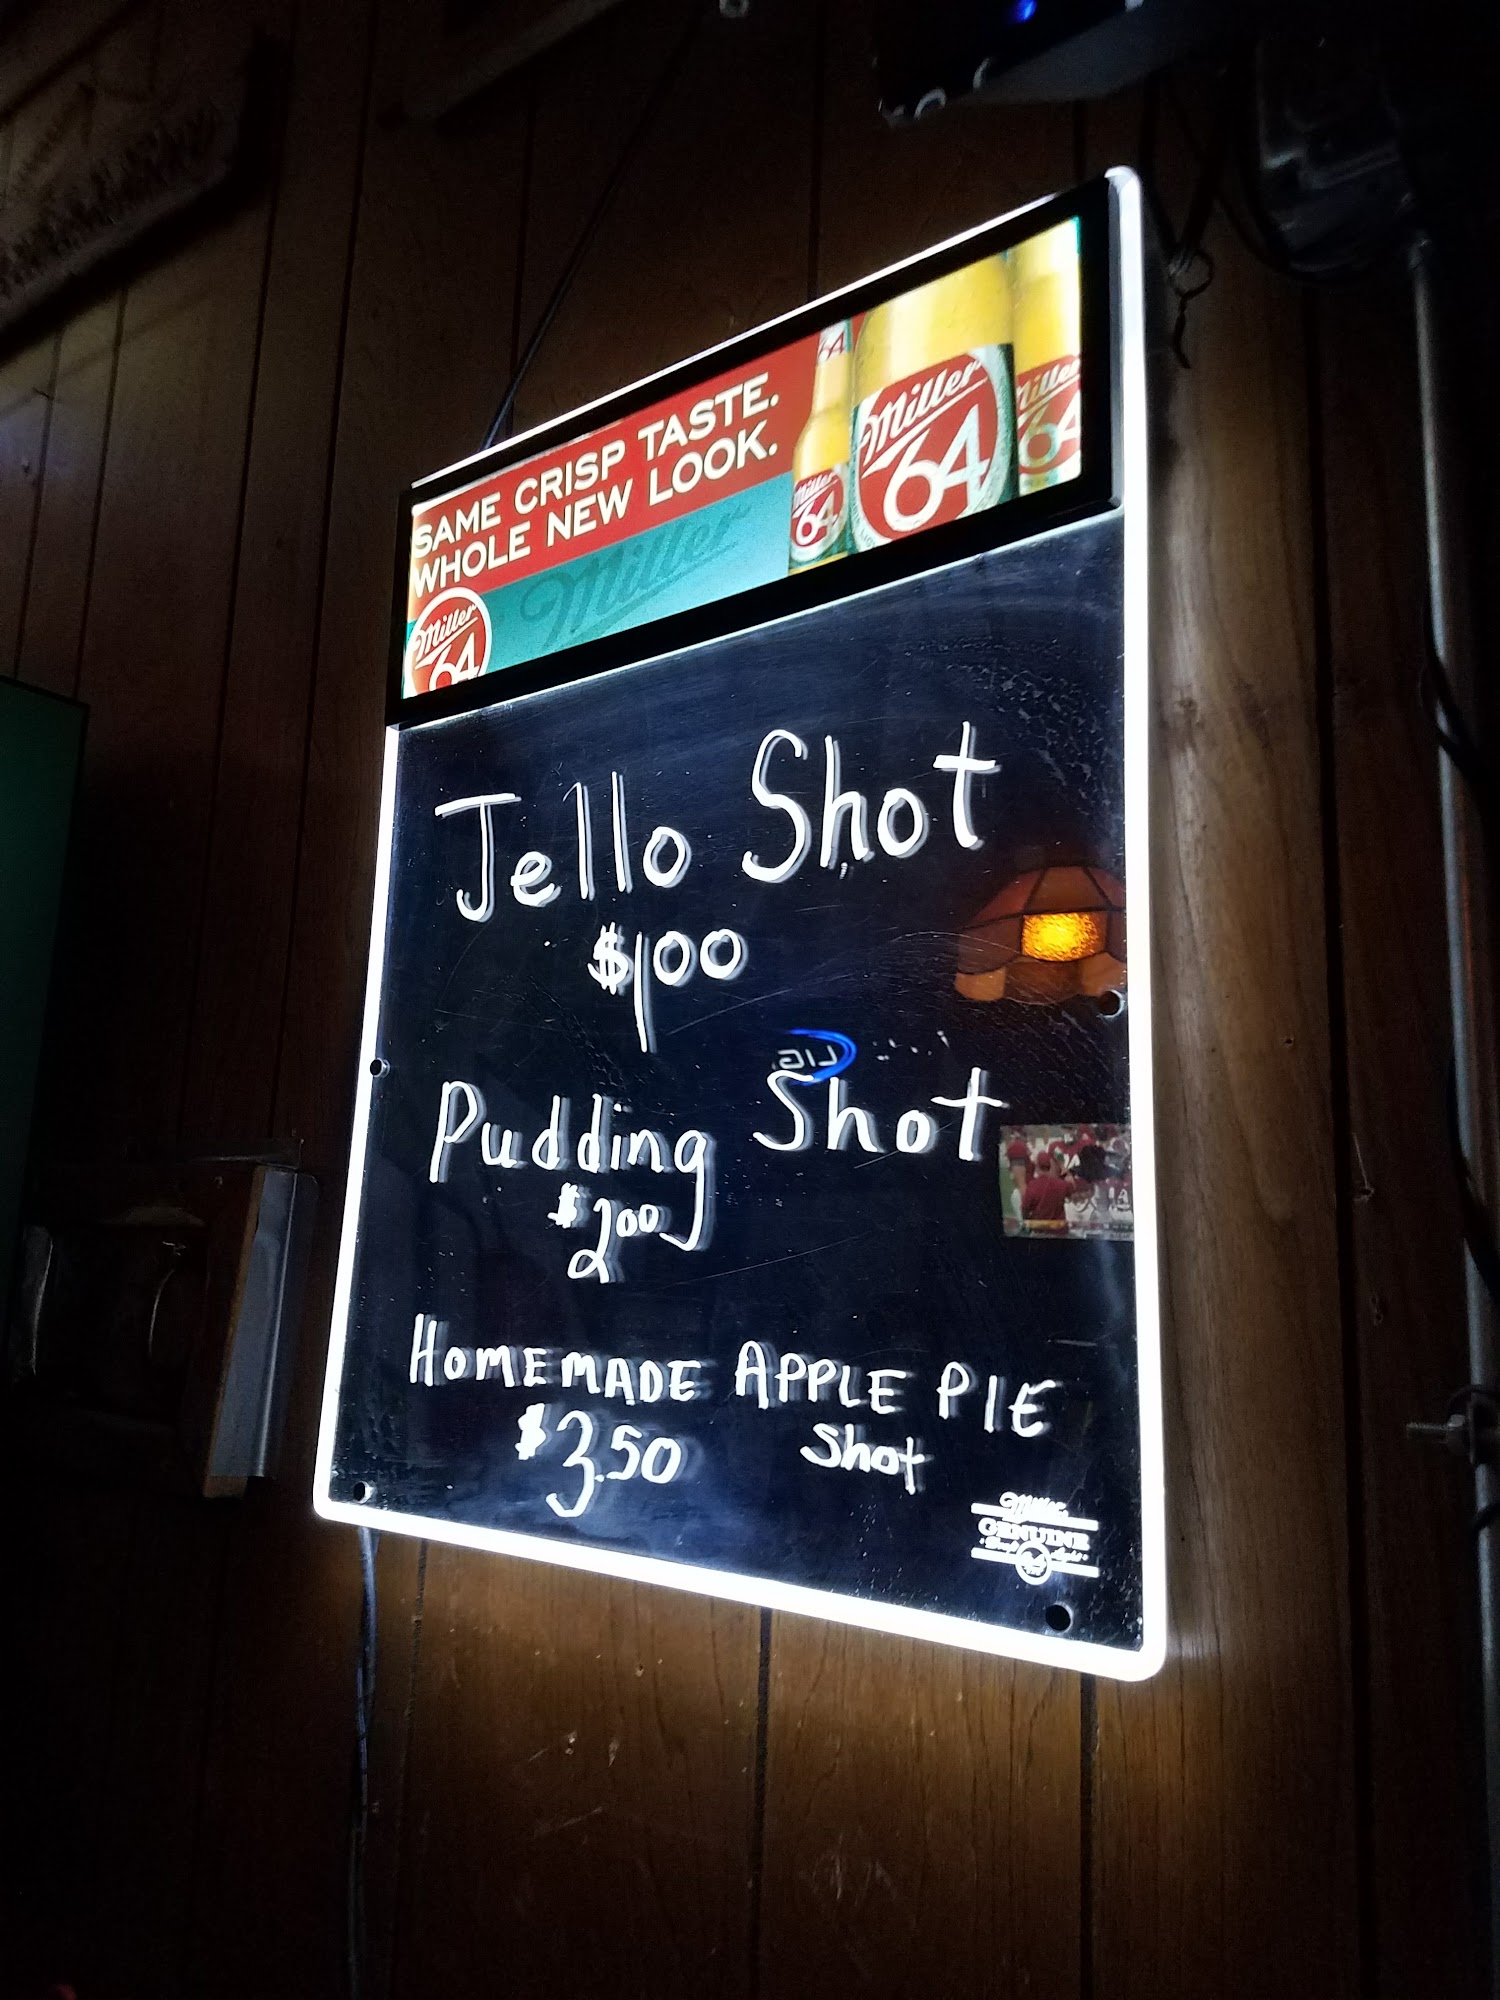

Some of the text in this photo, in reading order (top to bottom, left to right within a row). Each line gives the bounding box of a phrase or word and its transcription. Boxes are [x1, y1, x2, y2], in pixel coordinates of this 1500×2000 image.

[412, 371, 780, 558] SAME CRISP TASTE.
[859, 360, 984, 466] Miller
[883, 403, 991, 532] 64
[1018, 389, 1081, 468] 64
[412, 419, 779, 598] WHOLE NEW LOOK.
[795, 490, 838, 547] 64
[411, 603, 479, 663] Miller
[519, 502, 752, 649] Miller
[428, 631, 480, 692] 64
[434, 720, 999, 922] Jello Shot
[429, 1066, 1008, 1251] Pudding Shot
[734, 1340, 909, 1414] APPLE
[936, 1360, 1060, 1437] PIE
[514, 1402, 686, 1517] $3.50
